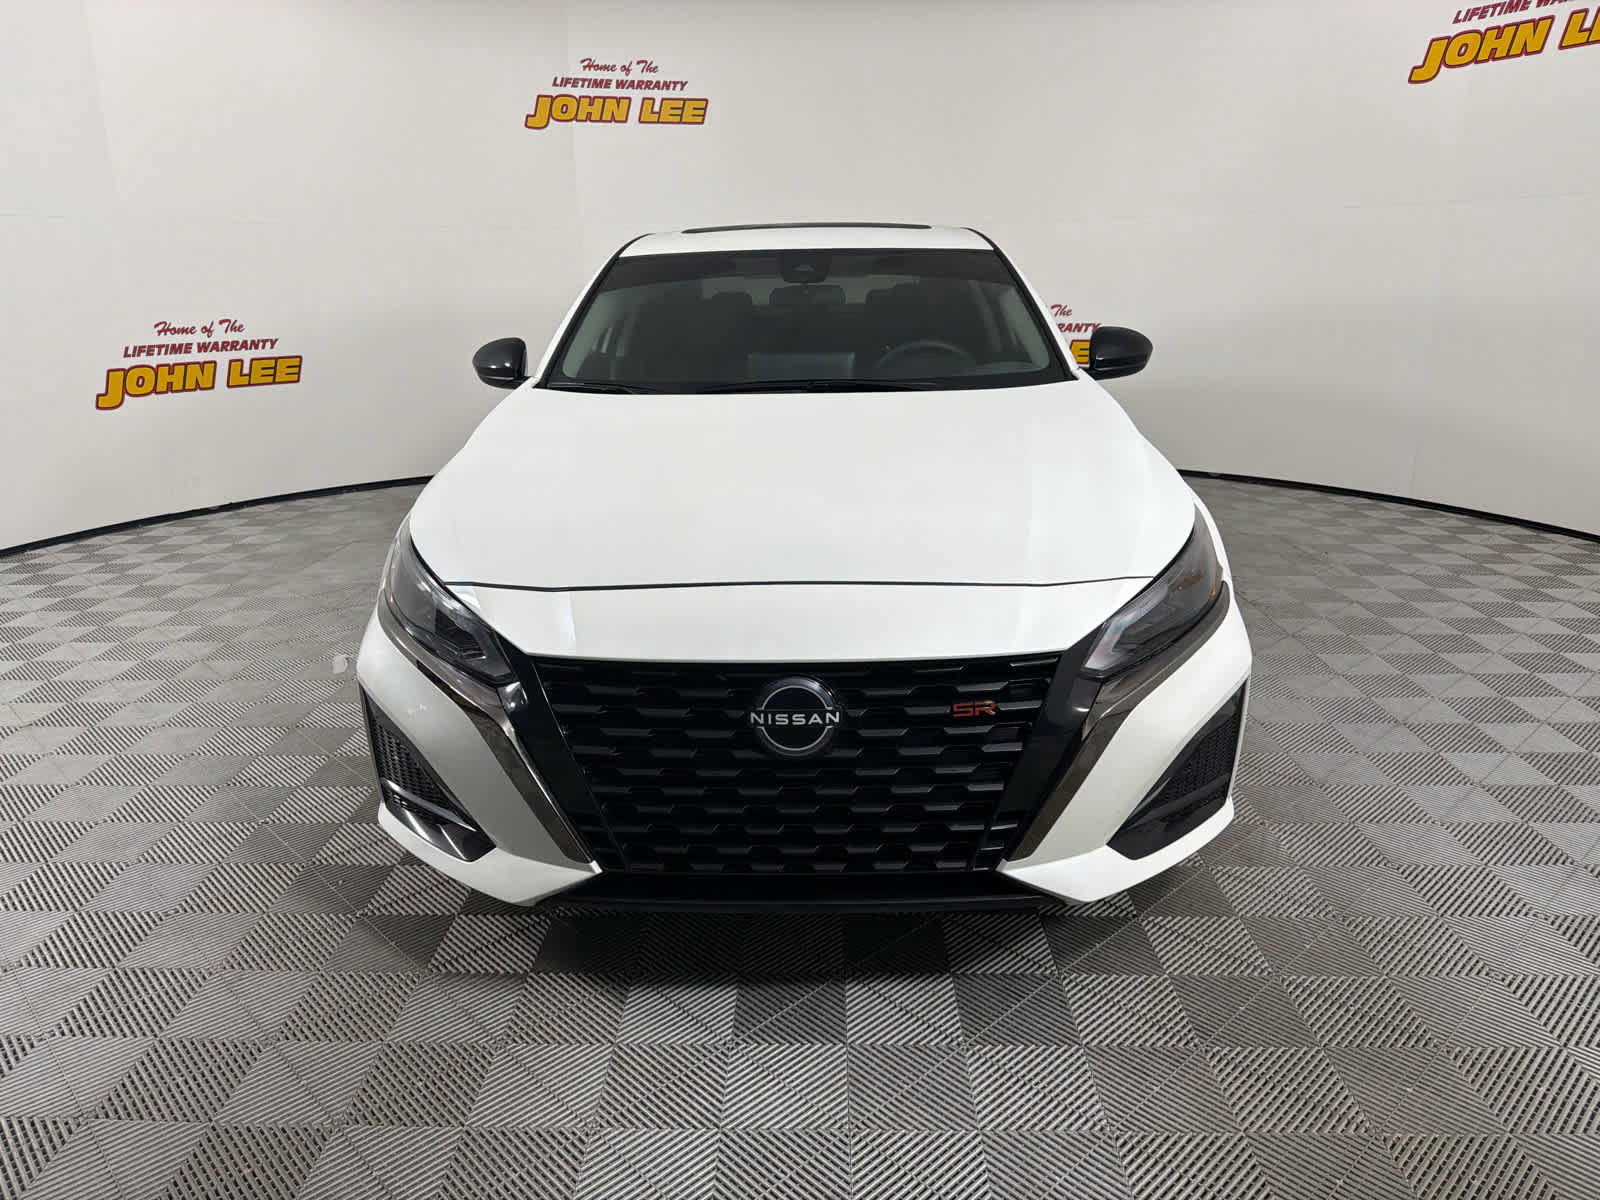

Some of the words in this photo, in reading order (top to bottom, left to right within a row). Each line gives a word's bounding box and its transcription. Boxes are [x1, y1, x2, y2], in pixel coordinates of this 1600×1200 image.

[1452, 0, 1532, 24] LIFETIME
[1408, 15, 1555, 84] JOHN
[580, 58, 617, 72] Home
[620, 61, 633, 76] of
[636, 60, 659, 73] The
[552, 77, 612, 89] LIFETIME
[615, 79, 688, 91] WARRANTY
[525, 94, 632, 130] JOHN
[639, 97, 708, 125] LEE
[1050, 303, 1072, 317] The
[154, 320, 197, 336] Home
[200, 321, 215, 338] of
[218, 318, 245, 334] The
[123, 342, 193, 358] LIFETIME
[196, 338, 279, 353] WARRANTY
[95, 360, 217, 411] JOHN
[226, 355, 303, 388] LEE
[750, 711, 840, 726] NISSAN
[952, 700, 996, 718] SR
